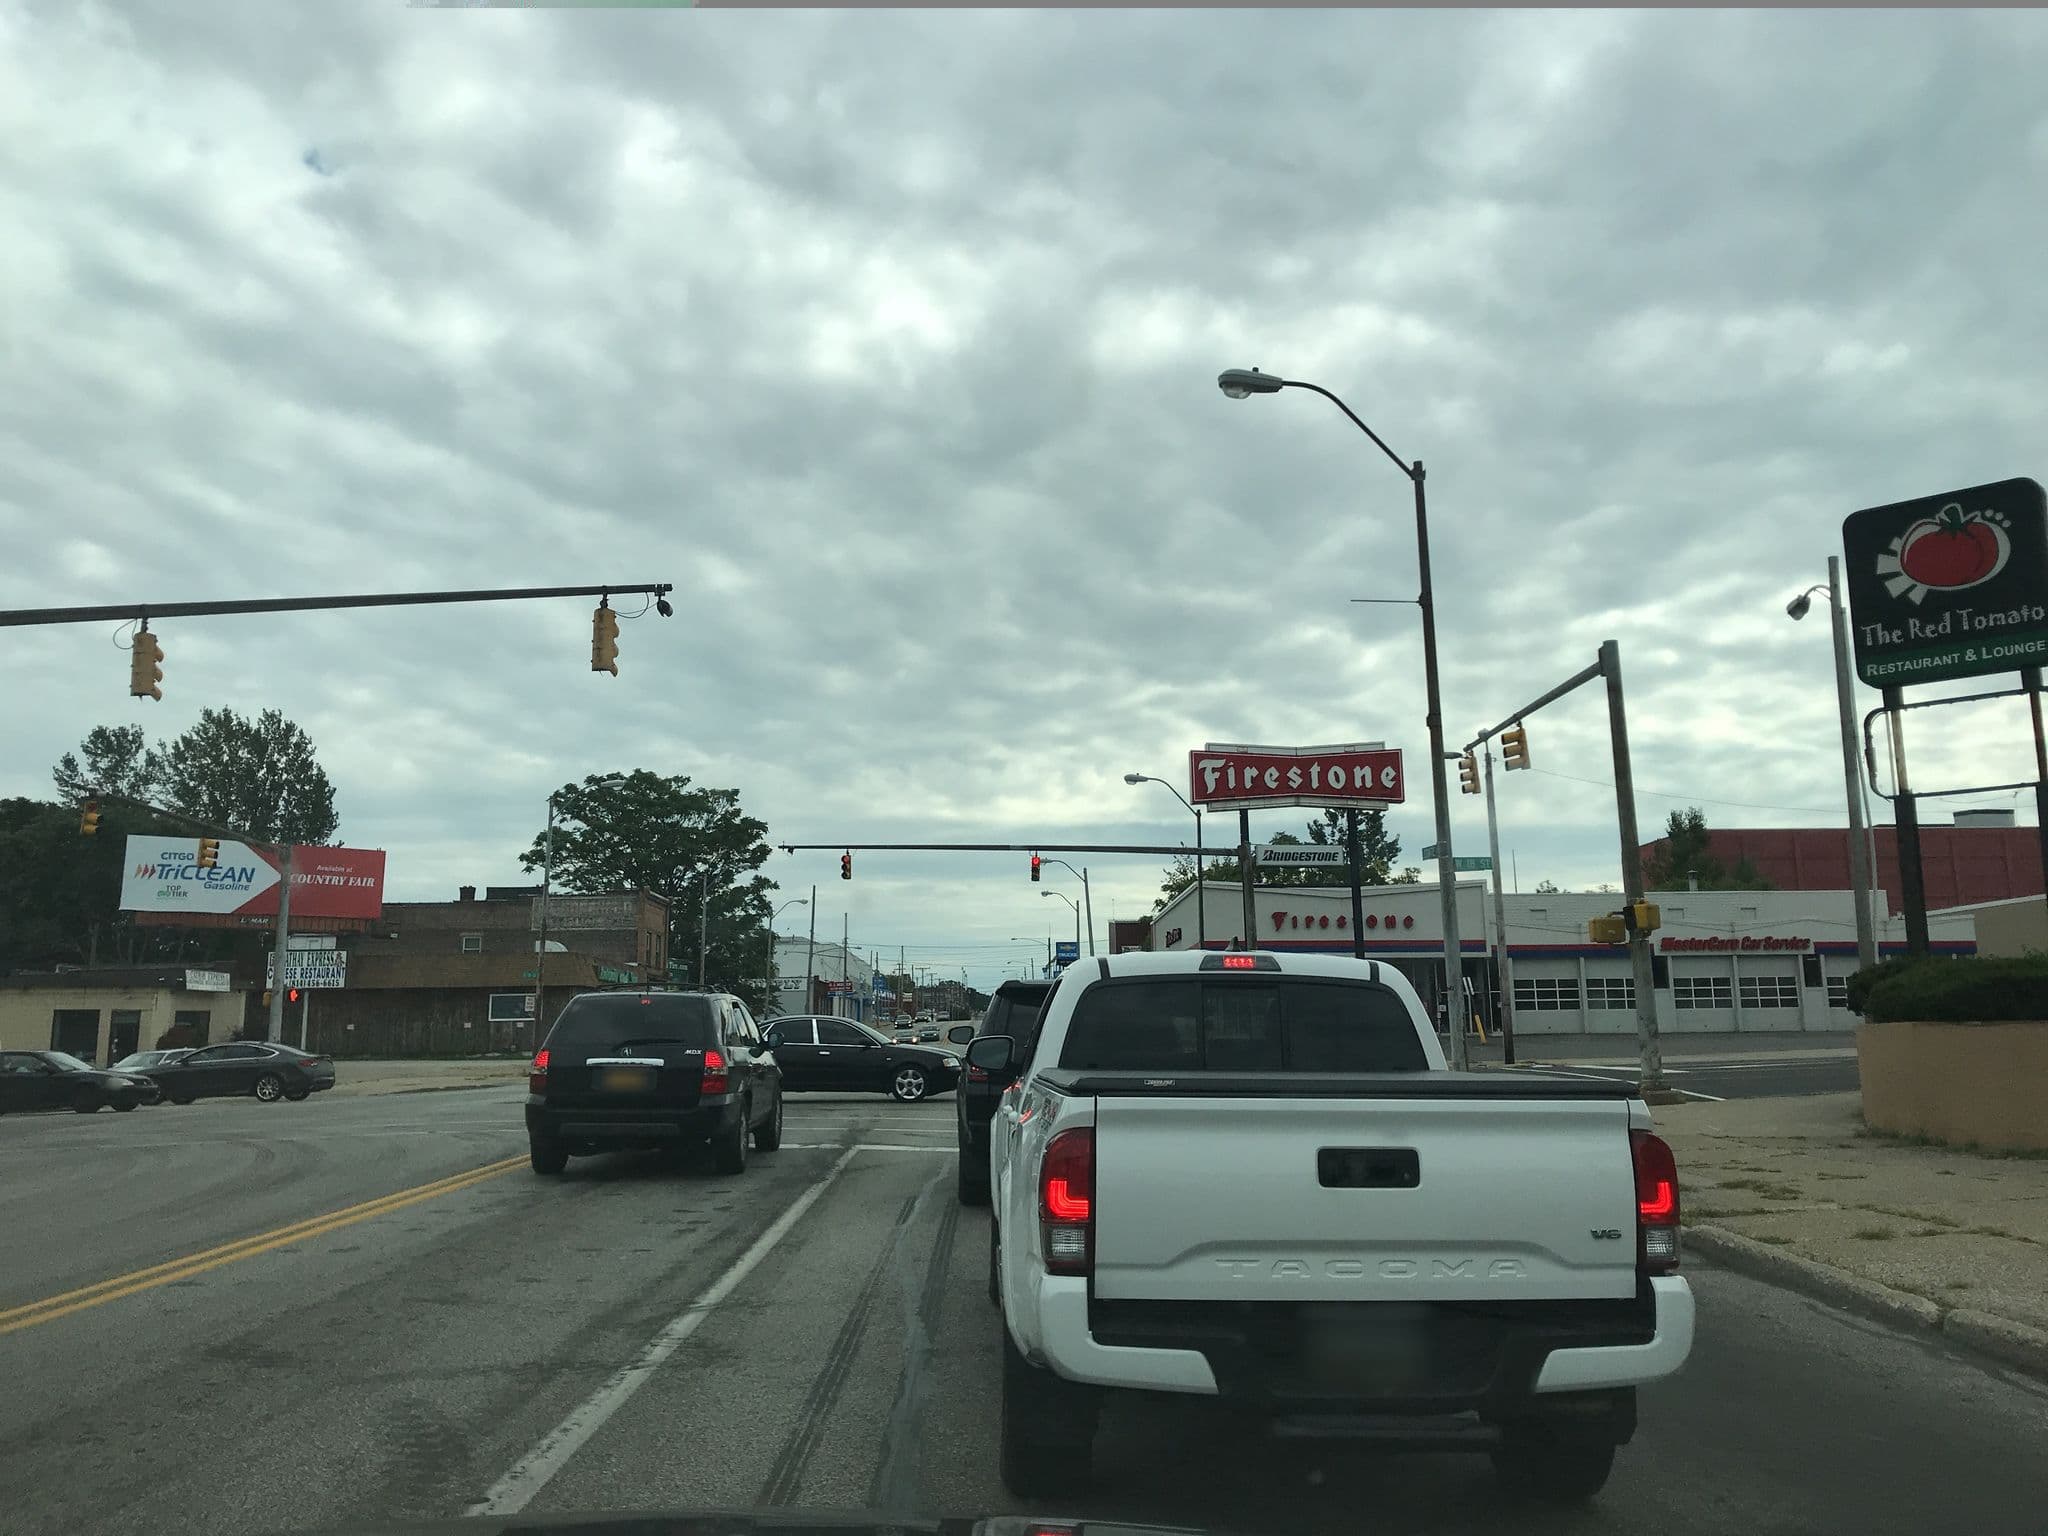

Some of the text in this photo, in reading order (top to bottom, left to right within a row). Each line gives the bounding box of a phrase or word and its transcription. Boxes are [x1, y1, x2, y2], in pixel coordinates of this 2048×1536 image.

[1860, 605, 2046, 646] The Red Tomato
[1866, 640, 2046, 677] RESTAURANT & LOUNGE
[1198, 758, 1398, 794] Firestone
[160, 851, 195, 861] CITGO
[1262, 849, 1340, 862] BRIDGESTONE
[157, 863, 256, 883] TriCLEAN
[290, 873, 375, 888] COUNTRY FAIR
[203, 880, 250, 891] Gasoline
[307, 951, 335, 966] EXPRESS
[300, 967, 346, 979] RESTAURANT
[1590, 1229, 1622, 1240] V6
[1215, 1258, 1528, 1279] TACOMA
